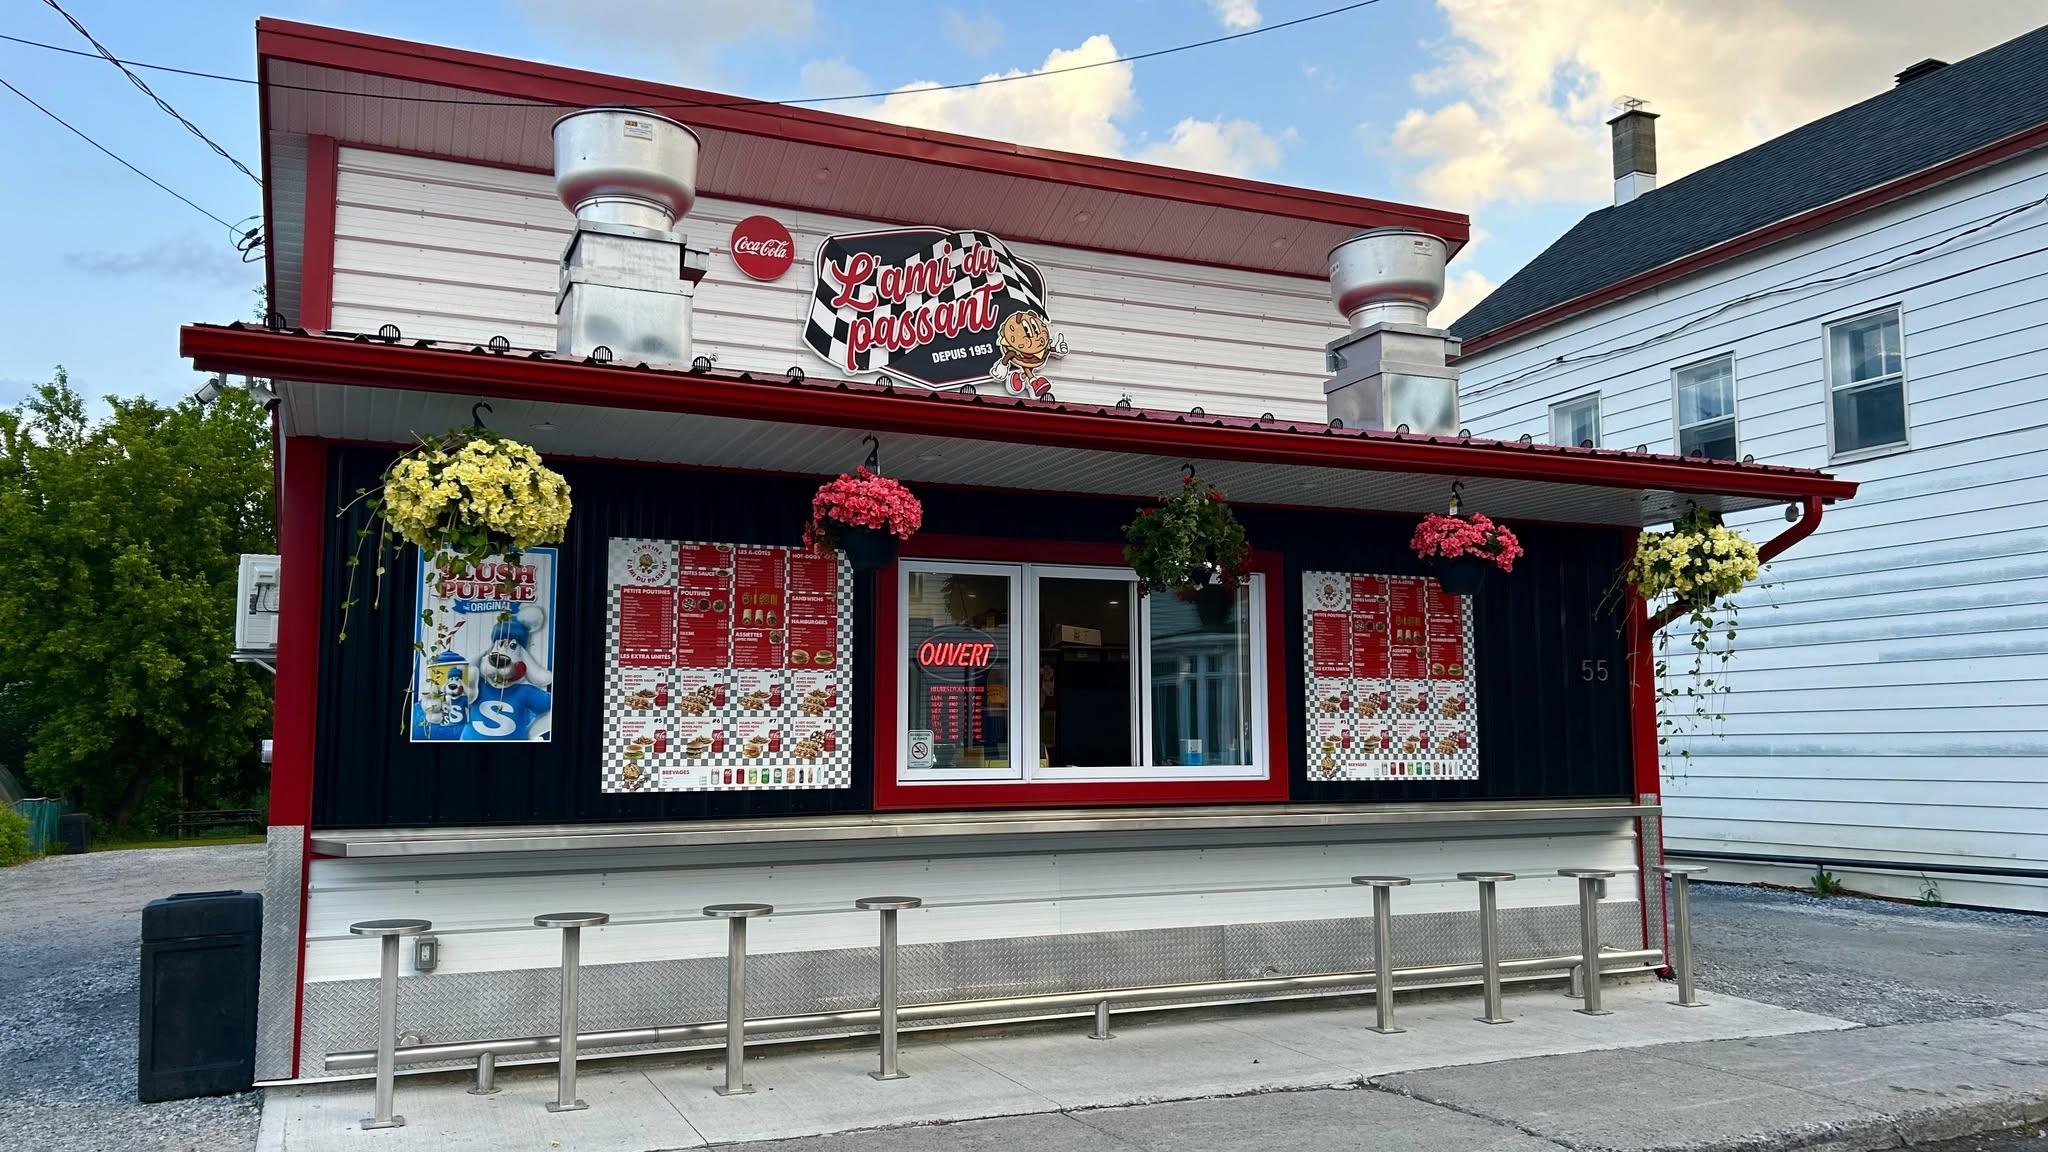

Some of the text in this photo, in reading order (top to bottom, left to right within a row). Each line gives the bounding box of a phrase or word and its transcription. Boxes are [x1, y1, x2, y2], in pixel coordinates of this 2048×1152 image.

[734, 235, 790, 258] Coca-Cola
[830, 240, 999, 311] L'ami du
[847, 279, 1004, 372] passant
[931, 343, 994, 363] DEPUIS 1953
[632, 544, 662, 556] CANTINE
[636, 574, 646, 584] DU
[648, 561, 668, 584] PASSANT
[470, 602, 511, 612] ORIGINAL
[920, 642, 994, 666] OUVERT
[1582, 660, 1608, 681] 55
[450, 705, 463, 723] S
[472, 700, 516, 736] S
